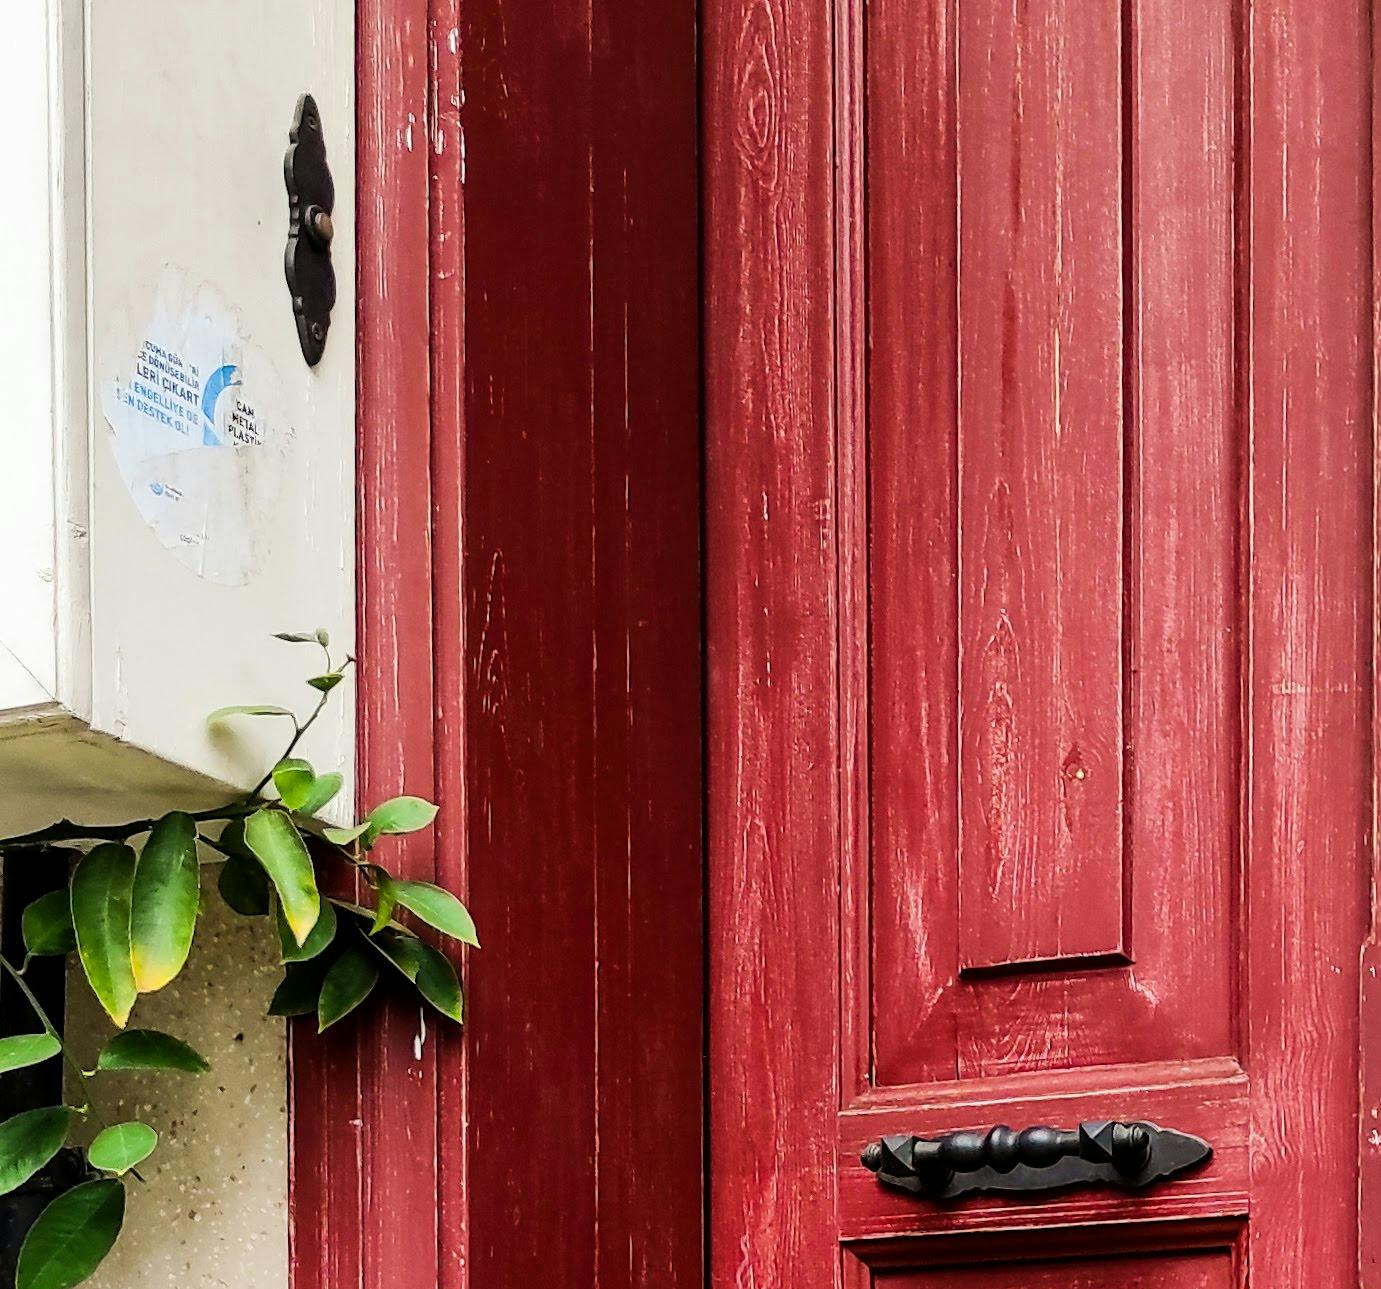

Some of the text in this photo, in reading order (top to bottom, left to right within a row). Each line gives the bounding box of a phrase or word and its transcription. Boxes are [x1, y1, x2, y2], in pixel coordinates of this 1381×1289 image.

[162, 377, 199, 406] ÇIKART
[137, 400, 172, 425] DESTEK
[232, 412, 259, 435] METAL
